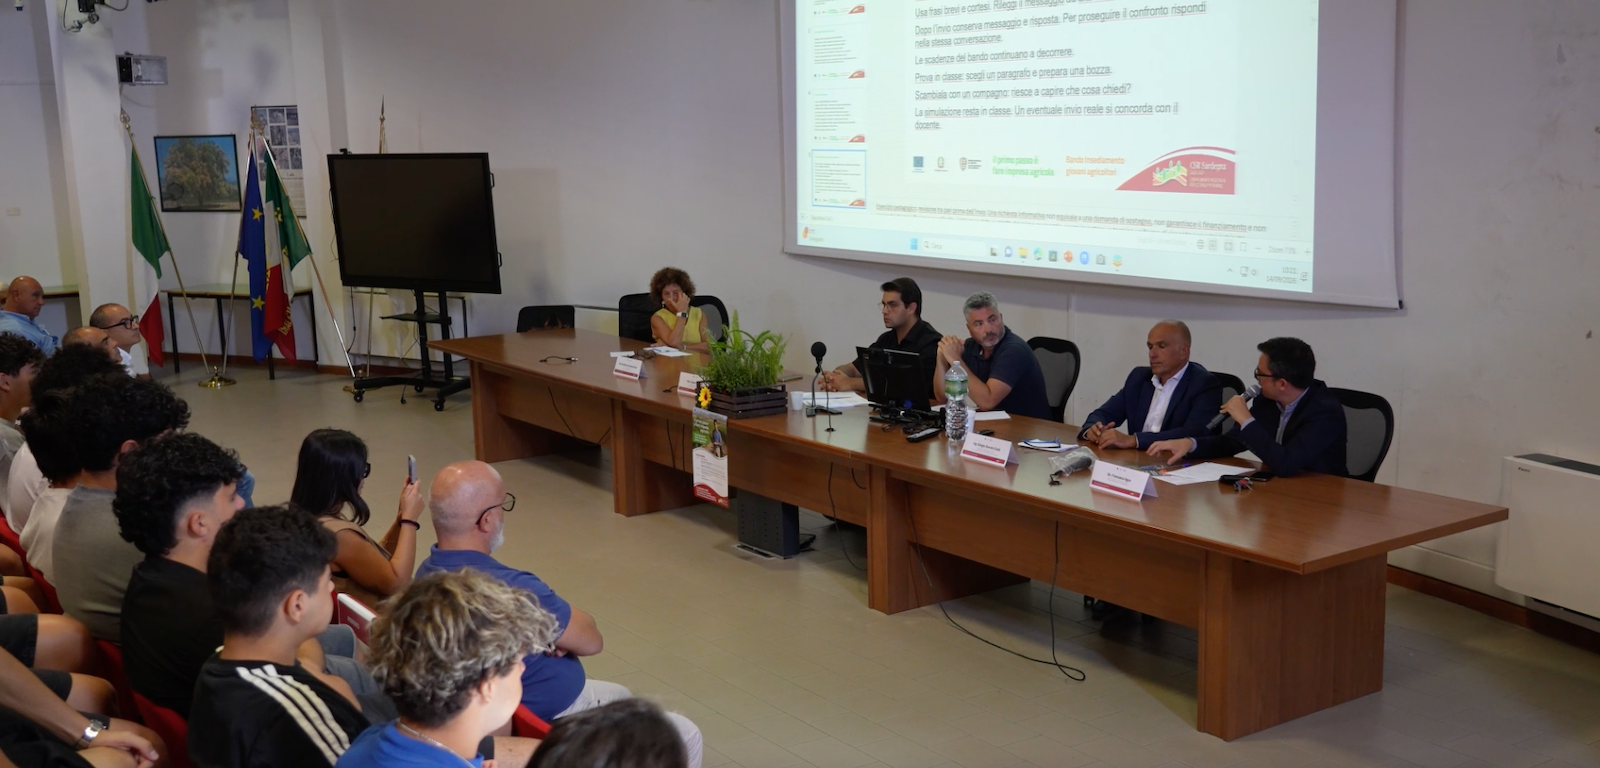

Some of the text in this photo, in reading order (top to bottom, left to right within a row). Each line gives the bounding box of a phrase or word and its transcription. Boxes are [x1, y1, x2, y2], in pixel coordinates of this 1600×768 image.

[915, 8, 928, 18] Usa
[929, 6, 942, 16] frasi
[944, 4, 960, 15] brevi
[967, 2, 992, 13] cortesi.
[993, 0, 1017, 11] Rileggi
[915, 25, 932, 36] Dopo
[933, 23, 951, 33] l'invio
[952, 21, 983, 32] conserva
[984, 18, 1022, 30] messaggio
[1029, 15, 1061, 27] risposta.
[1063, 13, 1077, 23] Per
[1078, 9, 1121, 24] proseguire
[1122, 8, 1127, 18] il
[1128, 5, 1169, 18] confronto
[1171, 1, 1207, 16] rispondi
[915, 33, 1003, 47] nella stessa conversazione.
[915, 47, 1074, 65] Le scadenze del bando continuano a decorrere.
[915, 64, 1112, 82] Prova in classe: scegli un paragrafo e prepara una bozza.
[915, 82, 1132, 99] Scambiala con un compagno: riesce a capire che cosa chiedi?
[915, 102, 1178, 117] La simulazione resta in classe. Un eventuale invio reale si concorda con il
[915, 121, 941, 130] docente.
[997, 156, 1014, 165] primo
[1015, 157, 1033, 165] passo
[1202, 161, 1227, 172] Sardegna
[1005, 167, 1029, 176] impresa
[1030, 168, 1055, 178] agricola
[1066, 167, 1086, 176] giovani
[1166, 220, 1196, 228] garantisce
[1203, 222, 1247, 231] finanziamento
